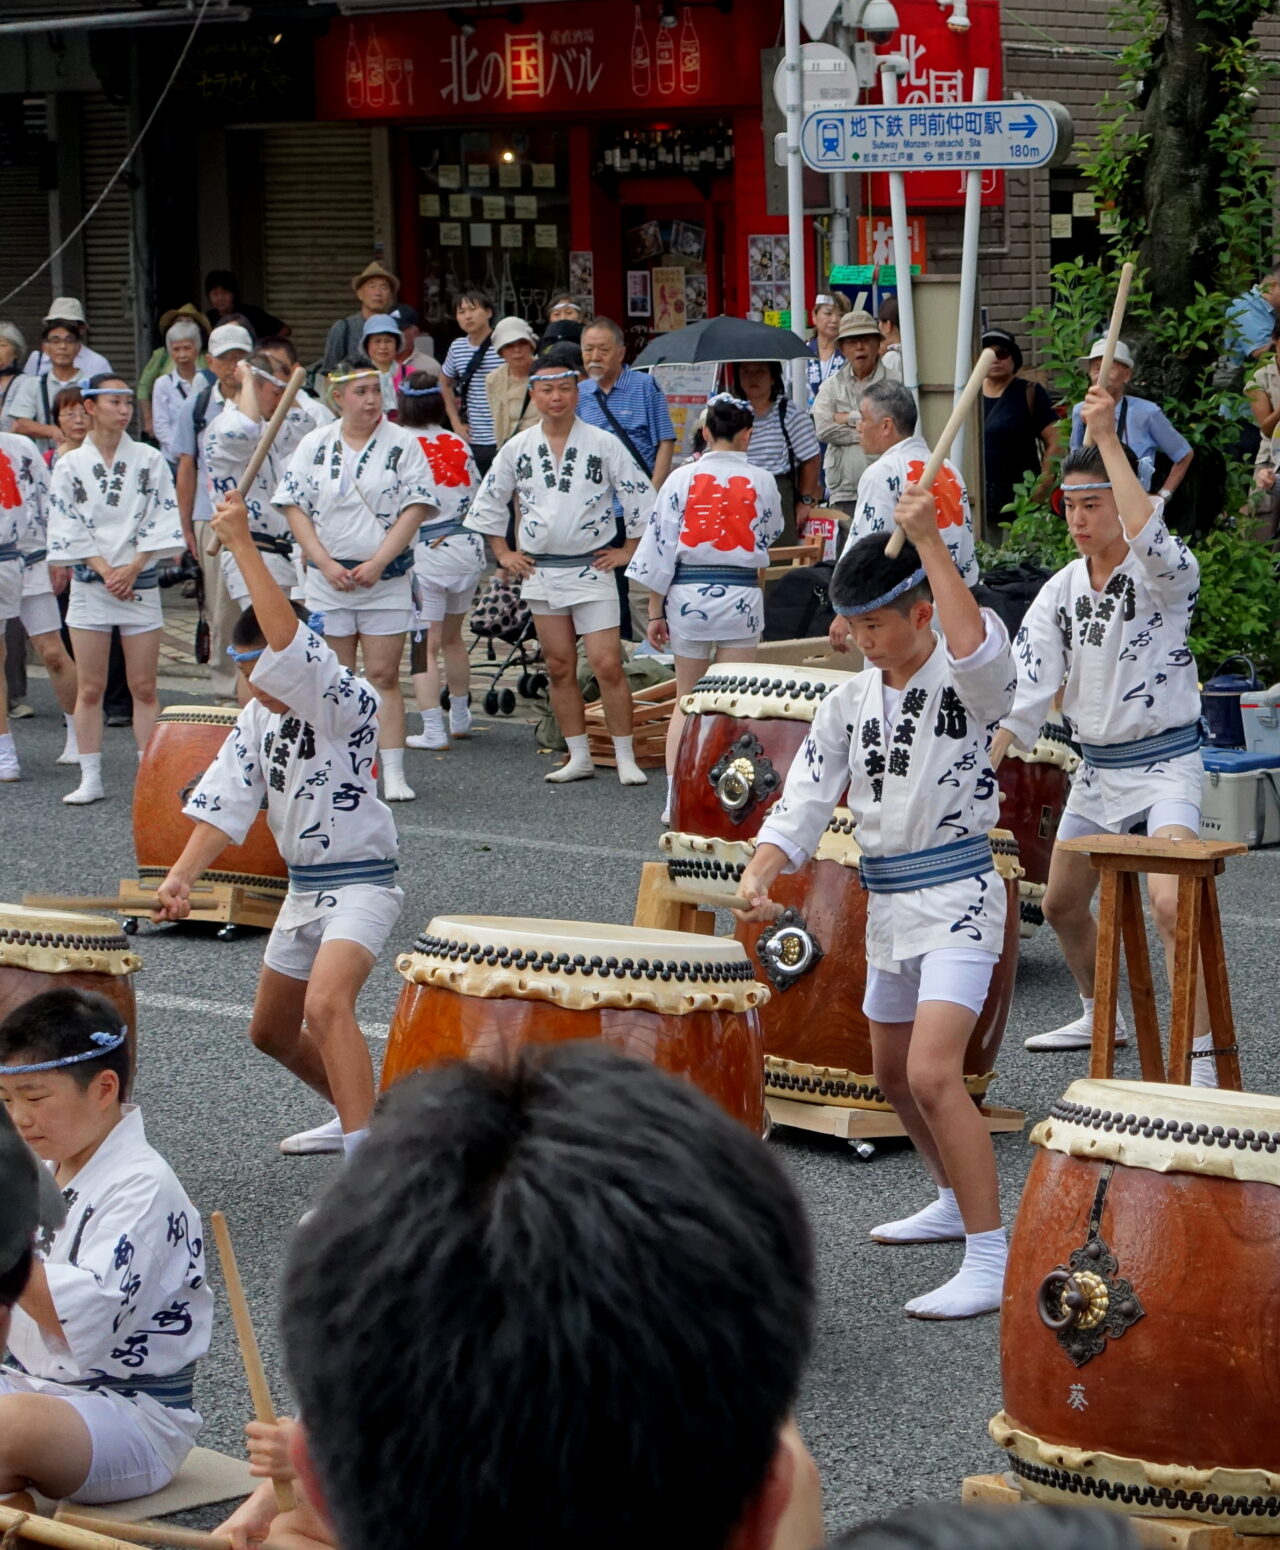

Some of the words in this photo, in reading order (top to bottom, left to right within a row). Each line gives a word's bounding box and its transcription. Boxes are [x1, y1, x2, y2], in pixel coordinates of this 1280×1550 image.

[440, 30, 602, 105] 北の国バル
[850, 114, 904, 138] 地下鉄
[909, 111, 1003, 137] 門前仲町駅
[872, 140, 898, 150] Subway
[1009, 145, 1040, 158] 180m
[558, 447, 578, 493] 葵太鼓
[679, 473, 758, 553] 鼓
[1087, 572, 1129, 647] 葵太鼓
[269, 716, 301, 793] 葵太鼓
[888, 687, 928, 778] 葵太鼓
[1067, 1384, 1088, 1411] 葵
